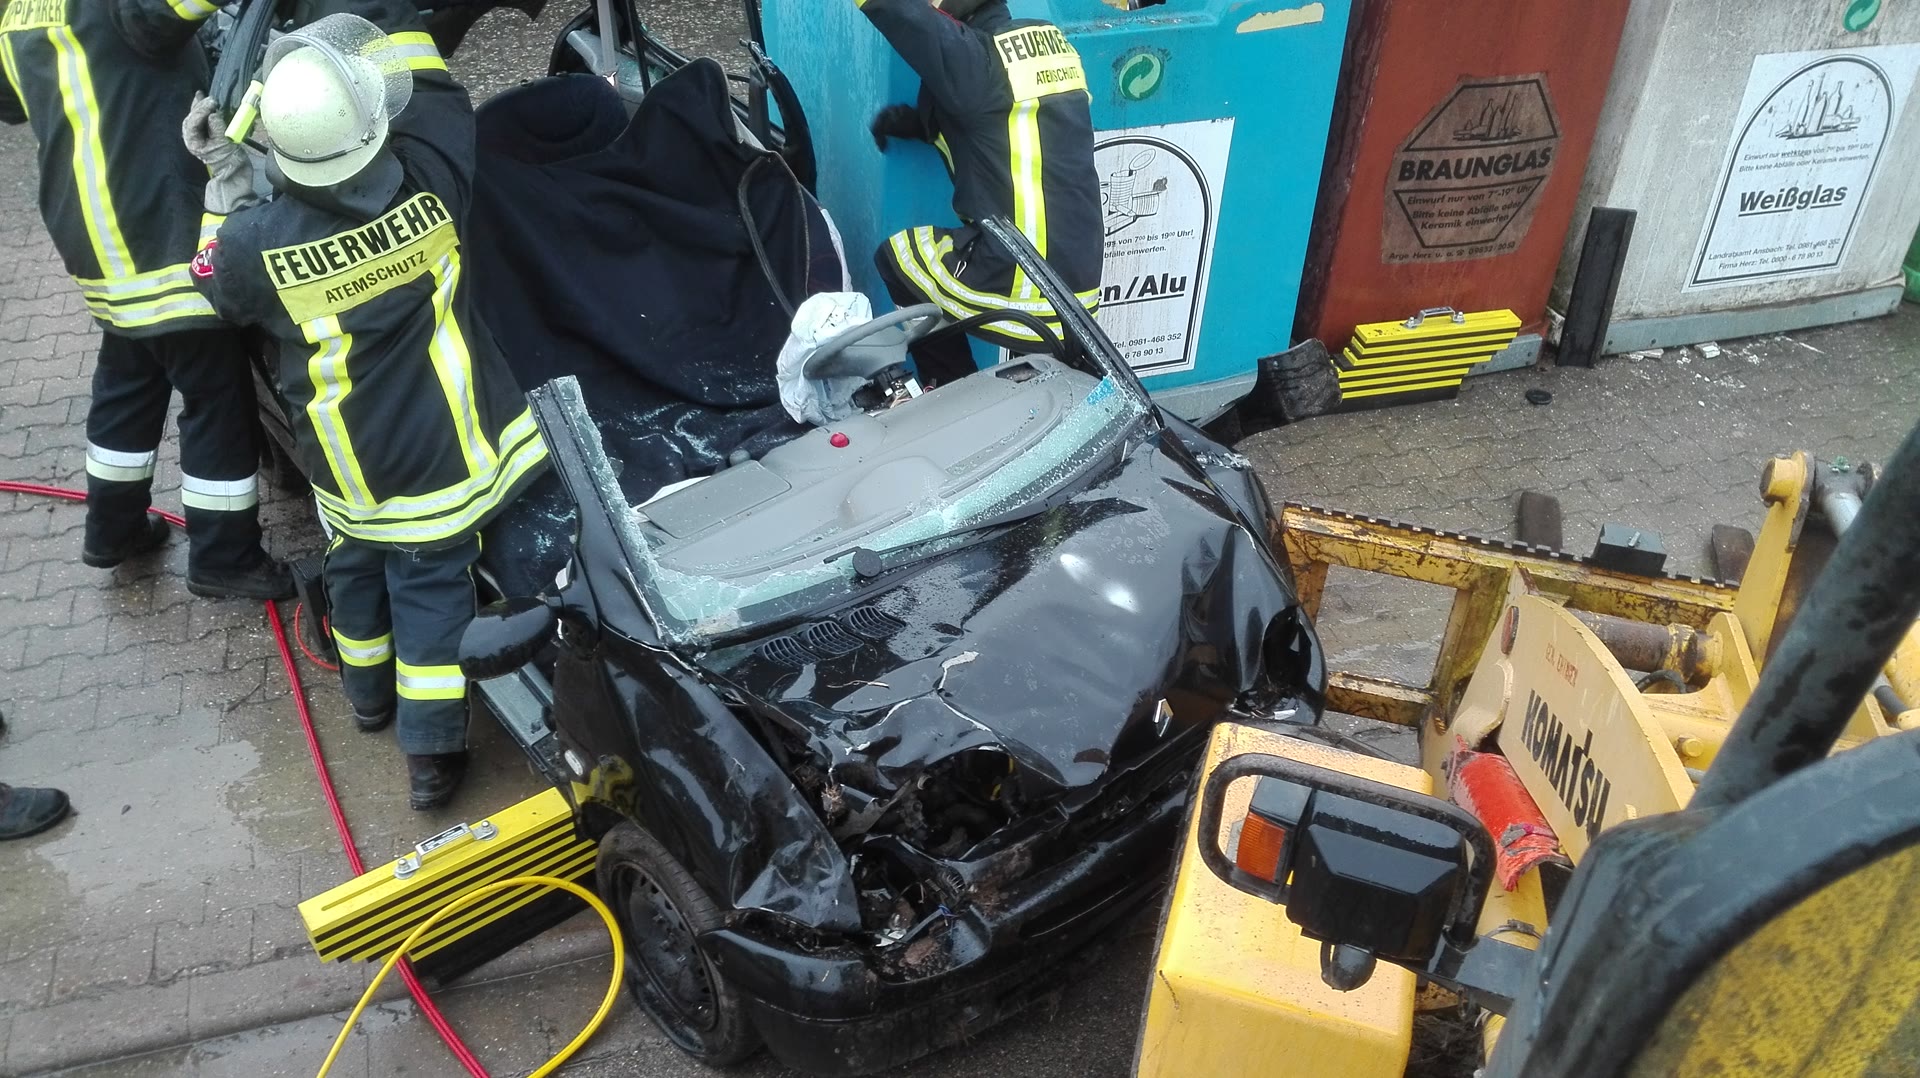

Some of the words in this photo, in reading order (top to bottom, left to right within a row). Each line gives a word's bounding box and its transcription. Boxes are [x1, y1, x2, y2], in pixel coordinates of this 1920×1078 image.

[998, 30, 1075, 63] FEUERWEH
[1744, 153, 1769, 161] Einwurf
[1812, 156, 1837, 165] Keramik
[1398, 147, 1552, 181] BRAUNGLAS
[1408, 195, 1446, 206] Einwurf
[1447, 195, 1465, 203] nur
[1740, 184, 1848, 212] Weißglas
[1412, 210, 1435, 219] Bitte
[1438, 208, 1464, 218] keine
[1467, 204, 1499, 216] Abfälle
[1501, 200, 1521, 210] oder
[1420, 220, 1462, 230] Keramik
[268, 194, 447, 285] FEUERWEHR
[1147, 234, 1158, 242] bis
[1177, 229, 1194, 238] Uhr!
[1104, 250, 1125, 258] bfälle
[1127, 246, 1166, 255] einwerfen.
[1718, 262, 1738, 270] Firma
[325, 250, 428, 304] ATEMSCHUTZ
[1128, 336, 1166, 347] 0981-468
[1168, 333, 1182, 341] 352
[1132, 350, 1142, 358] 78
[1144, 348, 1154, 356] 90
[1521, 688, 1612, 841] KOMATSU
